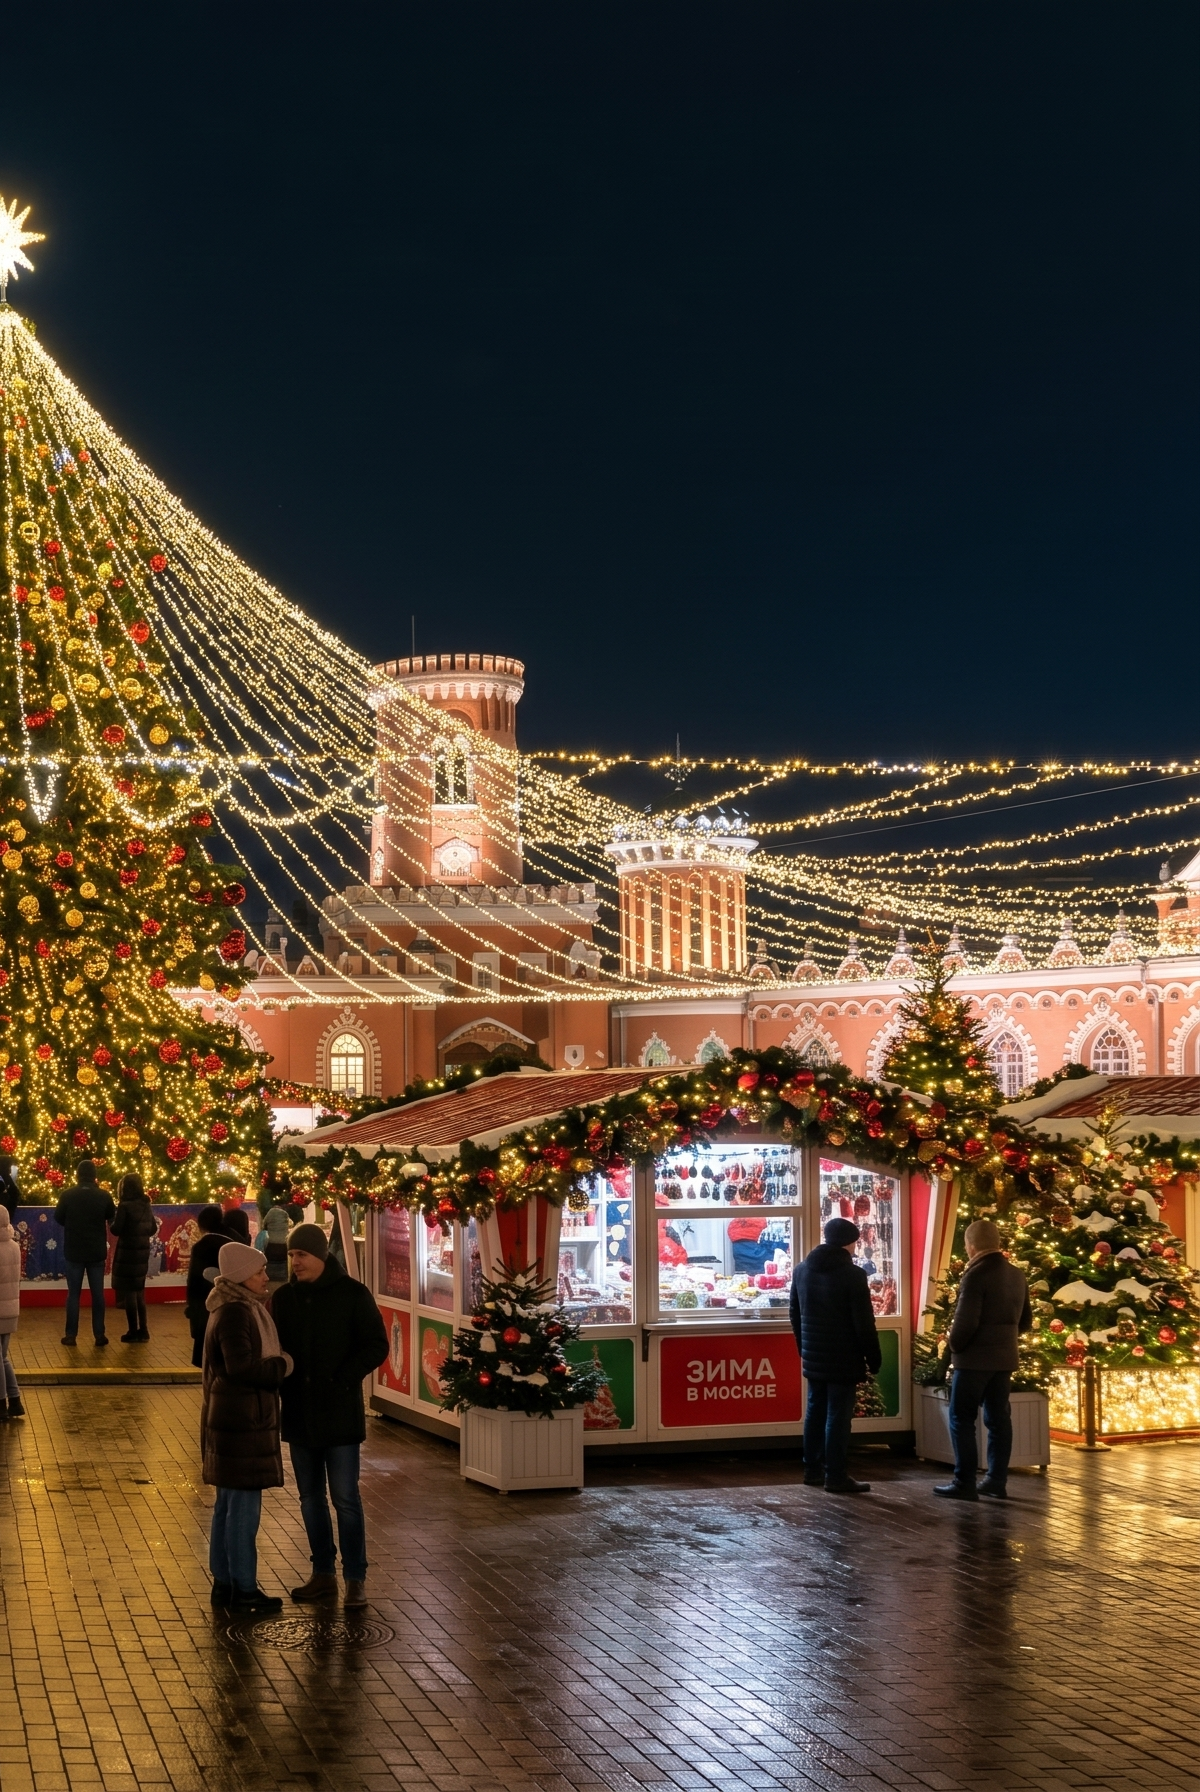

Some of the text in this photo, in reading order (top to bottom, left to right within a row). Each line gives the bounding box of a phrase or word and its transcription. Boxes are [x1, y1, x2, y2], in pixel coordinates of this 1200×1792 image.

[686, 1357, 776, 1384] ЗИМА
[687, 1383, 777, 1402] В МОСКВЕ
